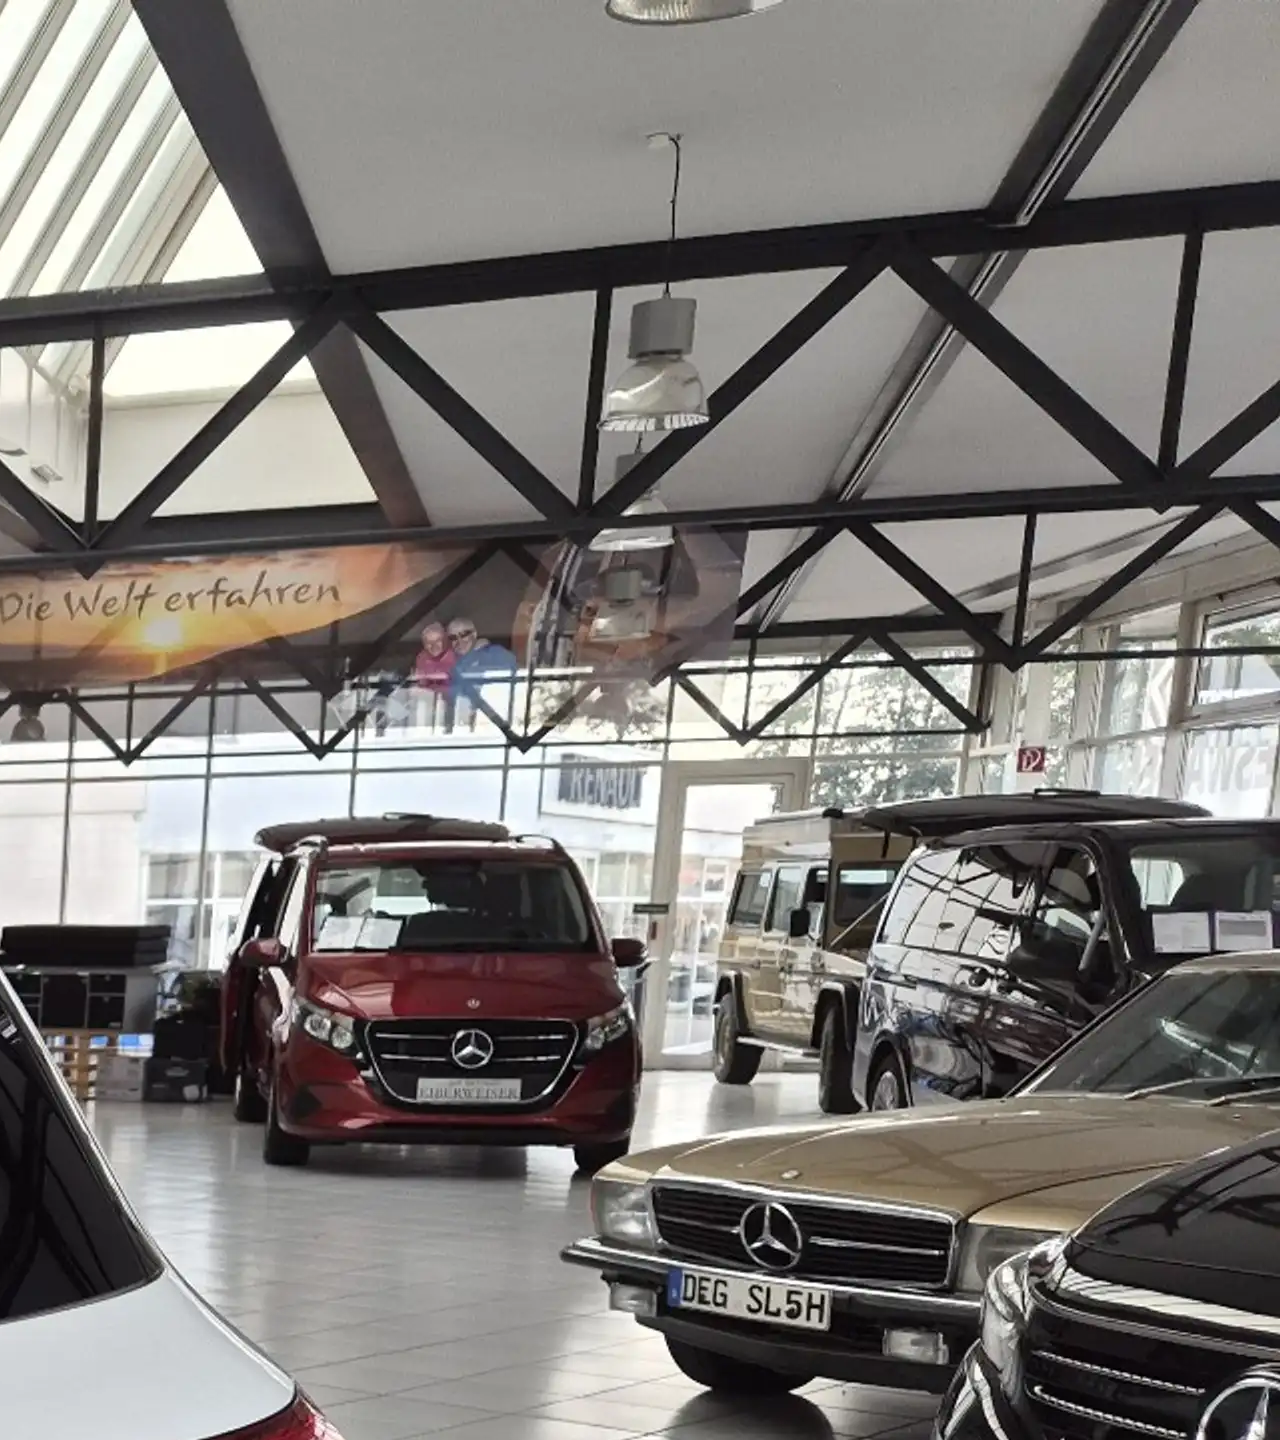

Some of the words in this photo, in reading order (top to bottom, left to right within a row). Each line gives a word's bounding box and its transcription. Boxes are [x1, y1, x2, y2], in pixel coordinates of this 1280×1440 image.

[64, 579, 159, 621] Welt
[163, 570, 341, 616] erfahren
[683, 1273, 728, 1308] DEG
